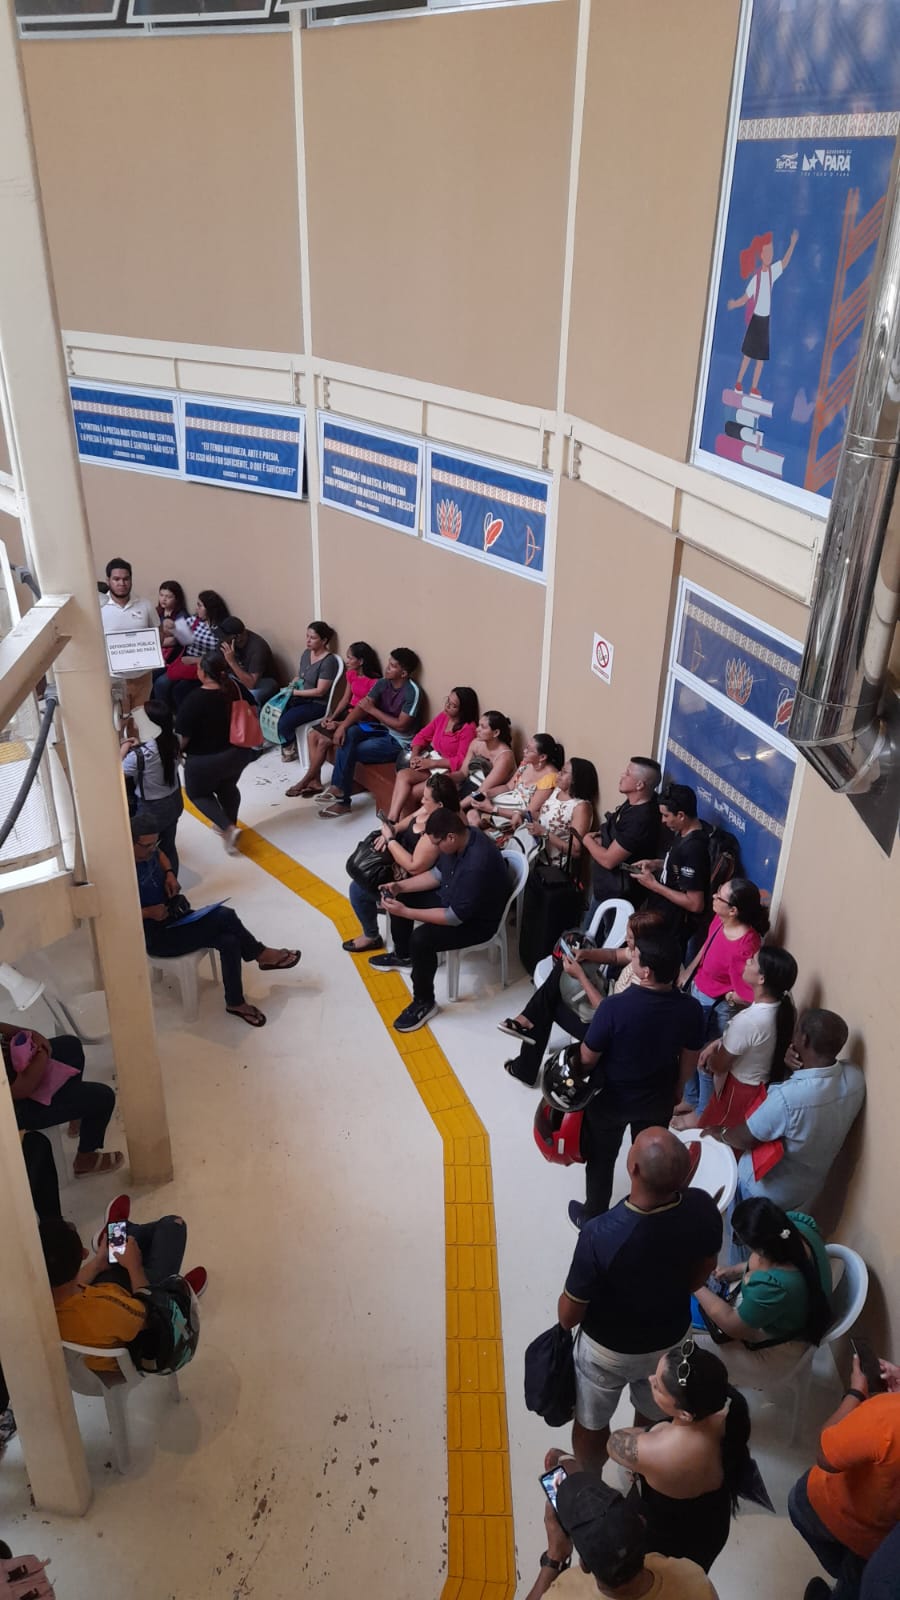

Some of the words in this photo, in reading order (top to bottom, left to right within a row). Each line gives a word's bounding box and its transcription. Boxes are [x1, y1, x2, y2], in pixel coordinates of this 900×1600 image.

[106, 426, 120, 435] POESIA
[121, 428, 130, 436] MAIS
[130, 429, 141, 438] VISTA
[86, 434, 99, 443] POESIA
[154, 442, 162, 452] NÃO
[210, 443, 223, 453] TENHO
[248, 450, 258, 459] ARTE
[190, 452, 195, 460] SE
[196, 452, 205, 462] ISSO
[206, 453, 214, 463] NÃO
[215, 456, 223, 465] FOR
[254, 462, 262, 471] QUE
[361, 474, 366, 483] UM
[358, 486, 363, 495] UM
[363, 488, 378, 500] ARTISTA
